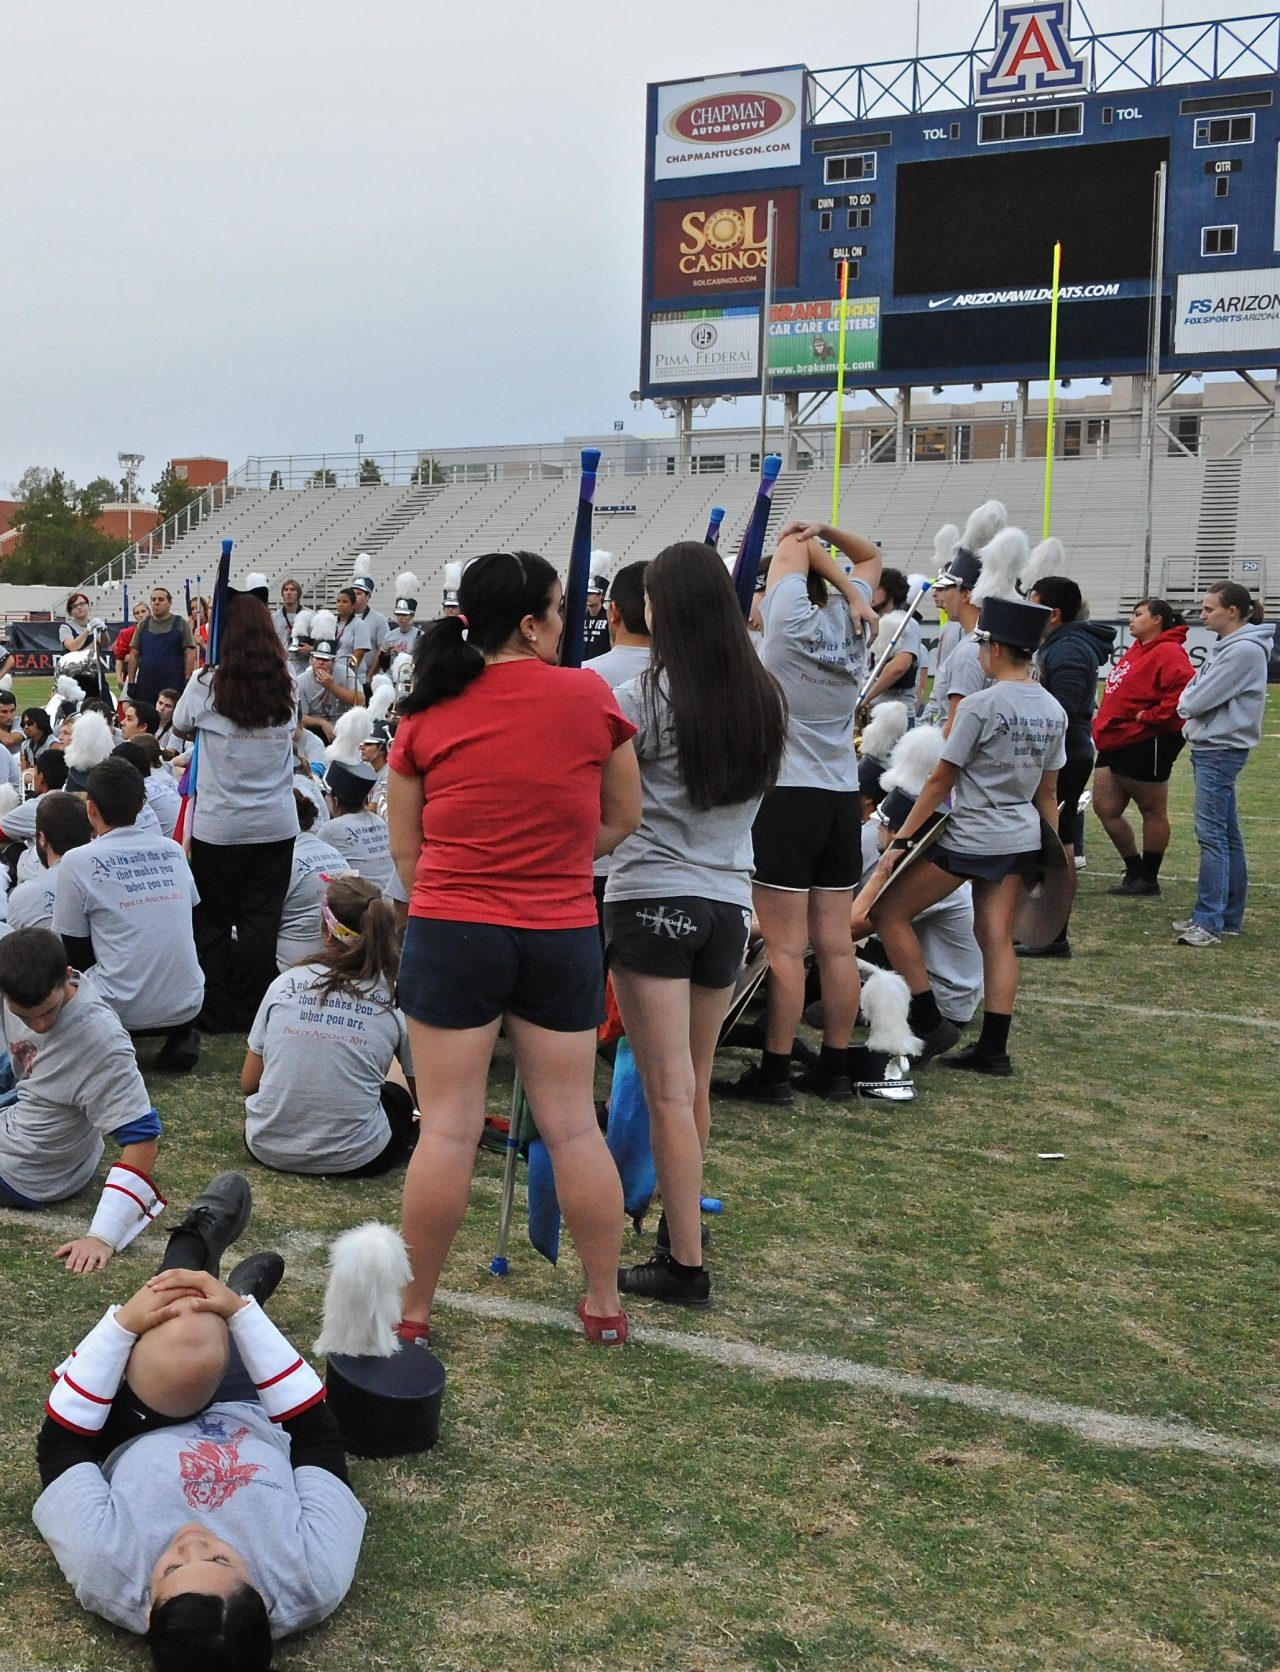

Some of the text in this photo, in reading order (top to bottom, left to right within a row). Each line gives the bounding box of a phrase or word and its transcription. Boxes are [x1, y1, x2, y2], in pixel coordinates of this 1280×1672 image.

[977, 1, 1087, 98] A
[691, 101, 765, 125] CHAPMAN
[1117, 108, 1142, 119] TOL
[692, 121, 765, 136] AUTOMOTIVE
[923, 129, 947, 140] TOL
[666, 143, 791, 163] CHAPMANTUCSON.COM
[1215, 162, 1230, 171] QTR
[818, 198, 834, 208] DWN
[849, 194, 870, 205] TO GO
[680, 206, 768, 254] SOL
[833, 247, 862, 257] BALL ON
[679, 250, 767, 274] CASINOS
[693, 276, 757, 286] SOLCASINOS.COM
[769, 302, 832, 322] BRAKE
[1188, 299, 1212, 314] FS
[769, 318, 875, 335] CAR CARE CETERS
[655, 351, 752, 366] PIMA FEDERAL
[1244, 563, 1257, 571] 29
[15, 654, 51, 669] EAR
[91, 856, 116, 879] And
[130, 852, 147, 863] only
[117, 865, 174, 881] that makes you
[125, 880, 162, 893] what you
[278, 978, 308, 997] And
[299, 994, 316, 1005] that
[355, 1002, 373, 1015] you
[300, 1010, 323, 1022] what
[326, 1014, 344, 1025] you
